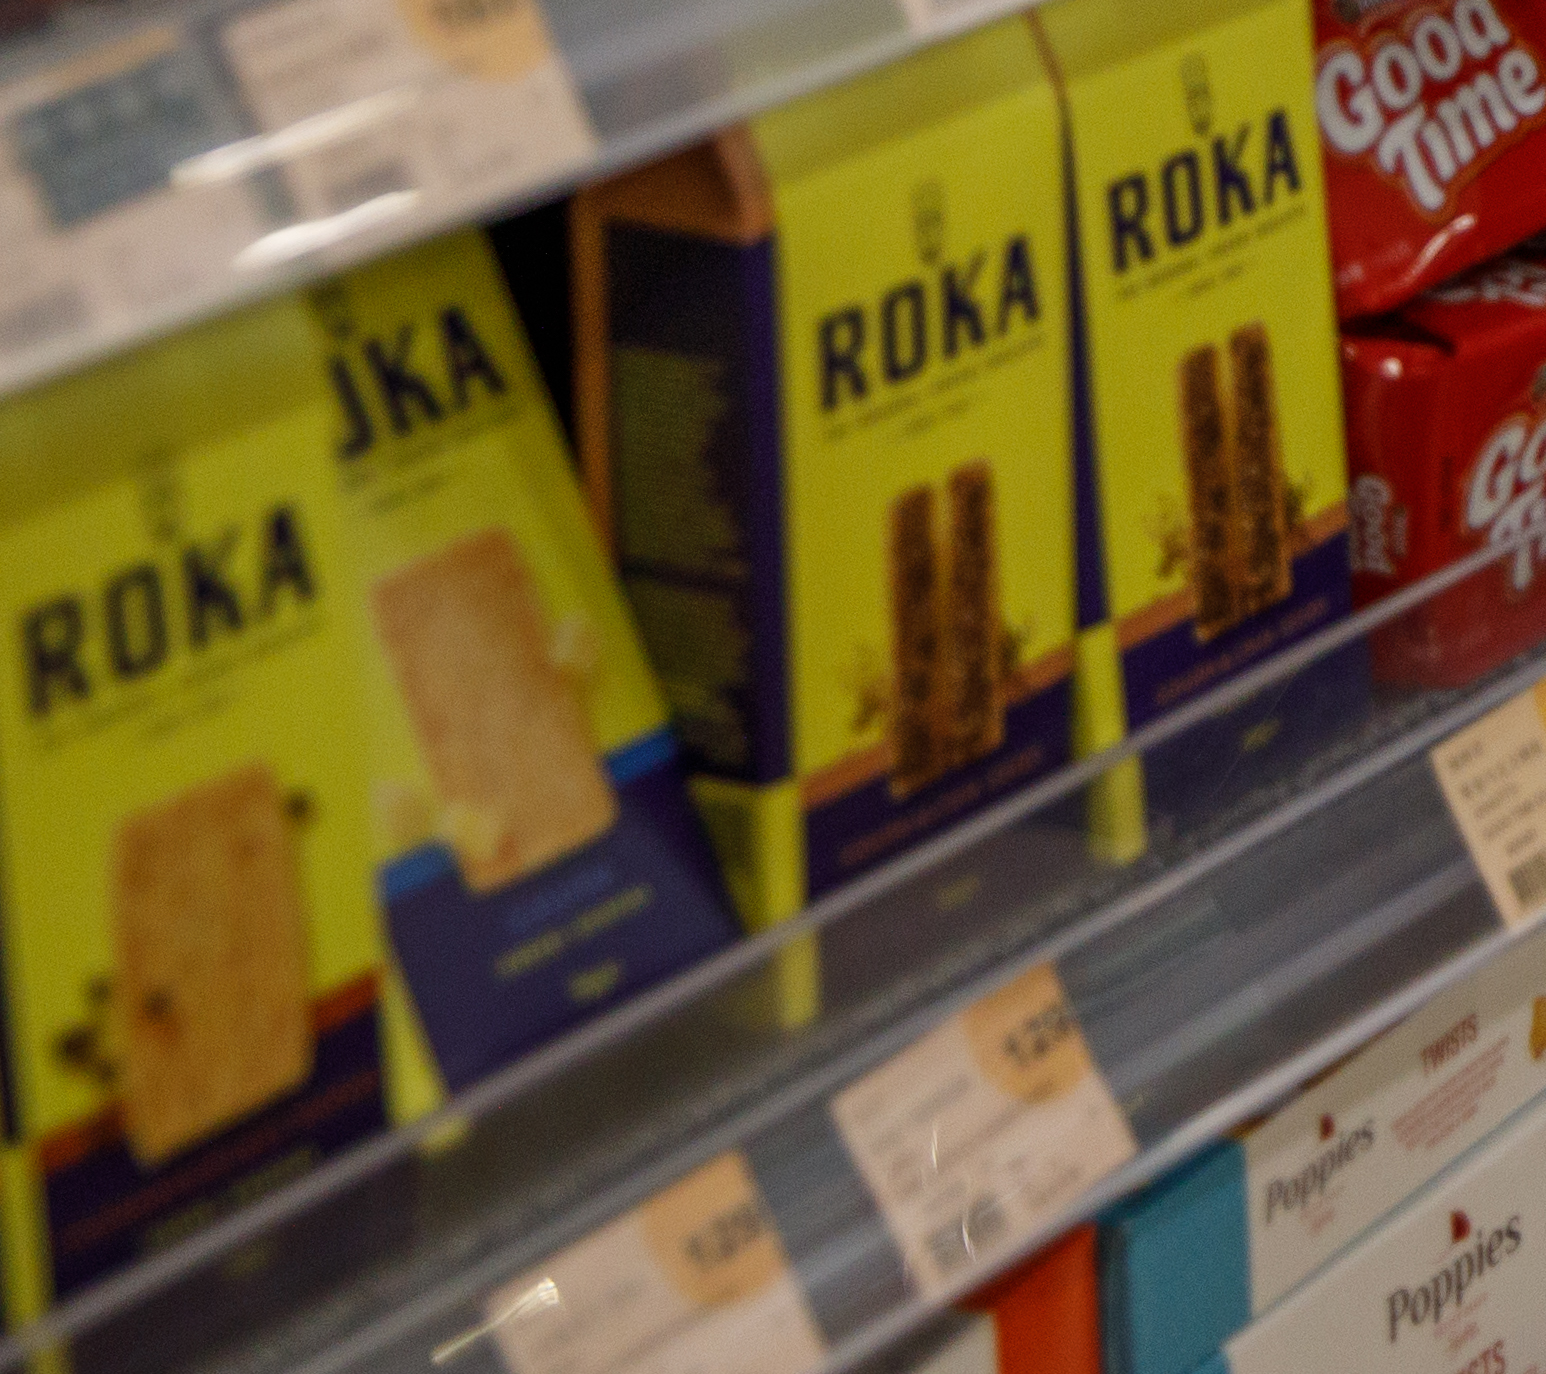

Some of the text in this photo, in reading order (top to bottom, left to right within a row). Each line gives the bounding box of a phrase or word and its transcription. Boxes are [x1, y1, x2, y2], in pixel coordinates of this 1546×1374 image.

[1105, 109, 1303, 276] ROKA
[1378, 47, 1546, 212] Time
[817, 236, 1042, 415] ROKA
[23, 505, 317, 719] ROKA
[1001, 1004, 1072, 1067] 129
[1420, 1011, 1482, 1073] TWISTS
[1264, 1115, 1375, 1224] Poppies
[1384, 1214, 1523, 1345] Poppies
